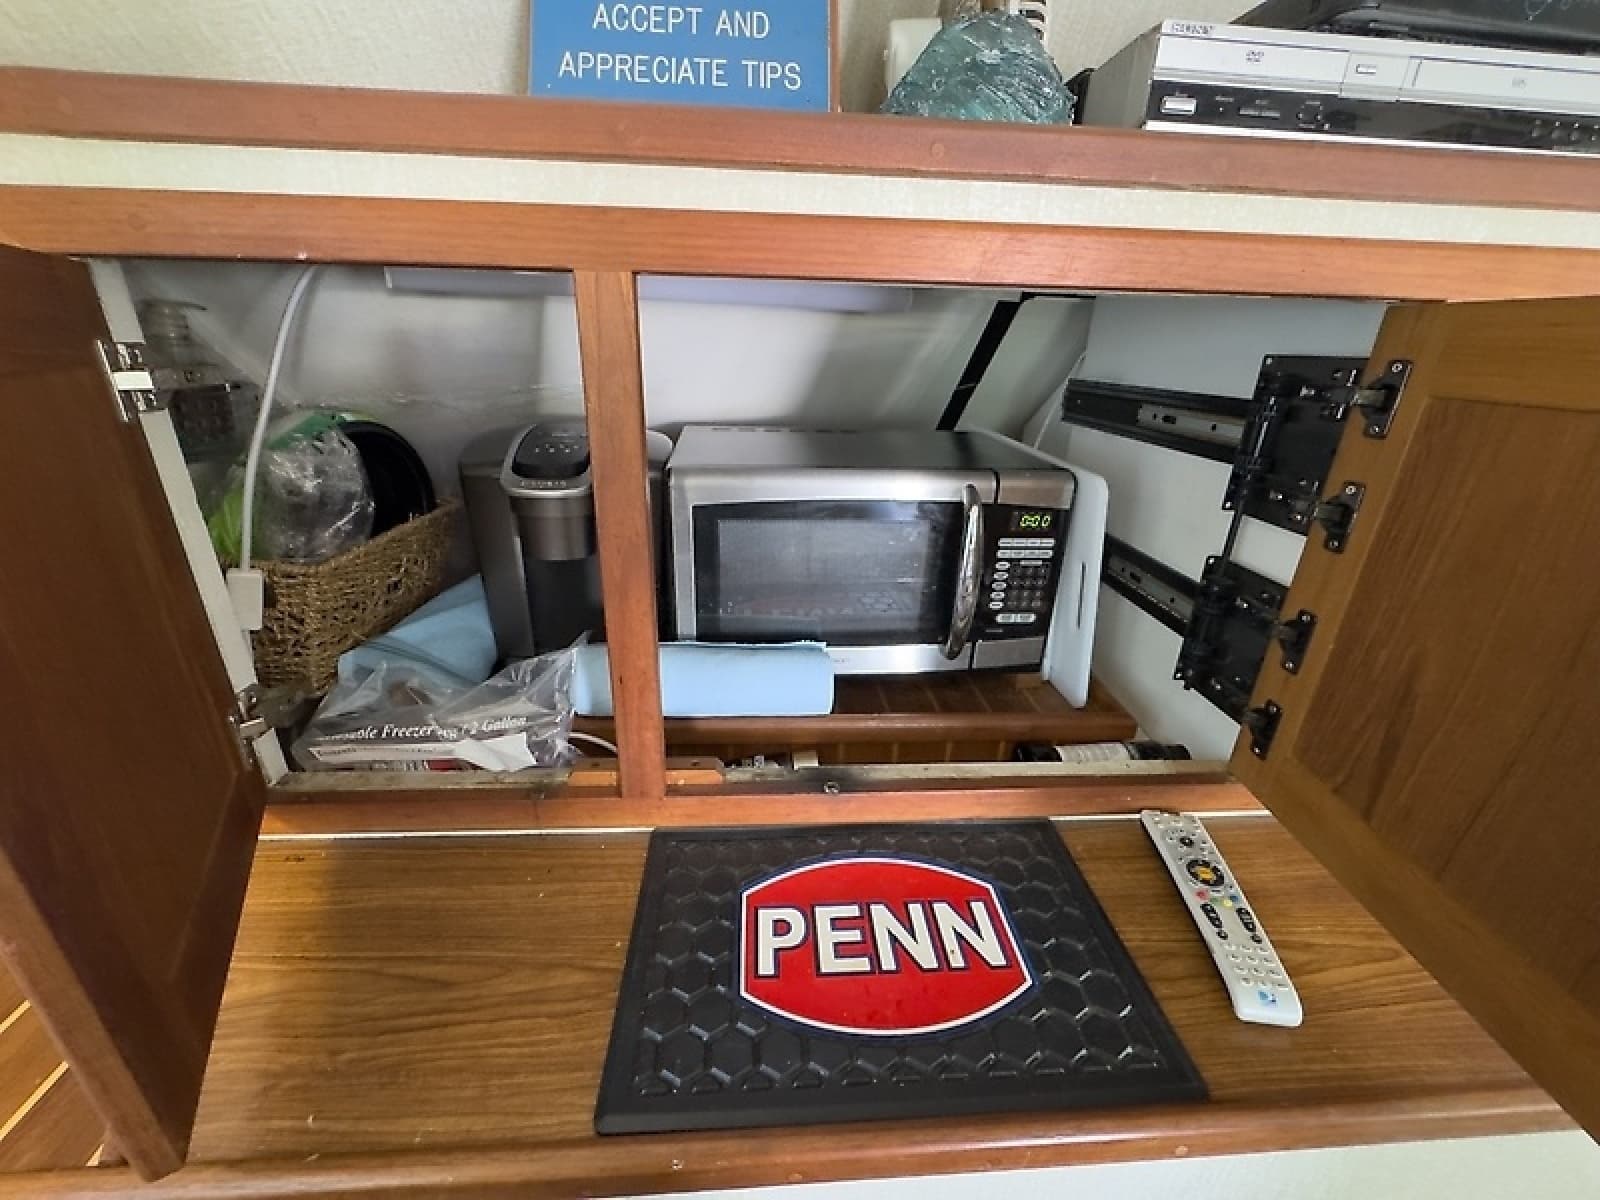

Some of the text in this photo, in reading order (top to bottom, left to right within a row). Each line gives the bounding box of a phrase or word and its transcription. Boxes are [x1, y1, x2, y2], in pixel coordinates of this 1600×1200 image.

[592, 3, 770, 39] ACCEPT AND
[558, 50, 802, 91] APPRECIATE TIPS
[381, 723, 433, 739] Freezer
[755, 899, 1008, 978] PENN
